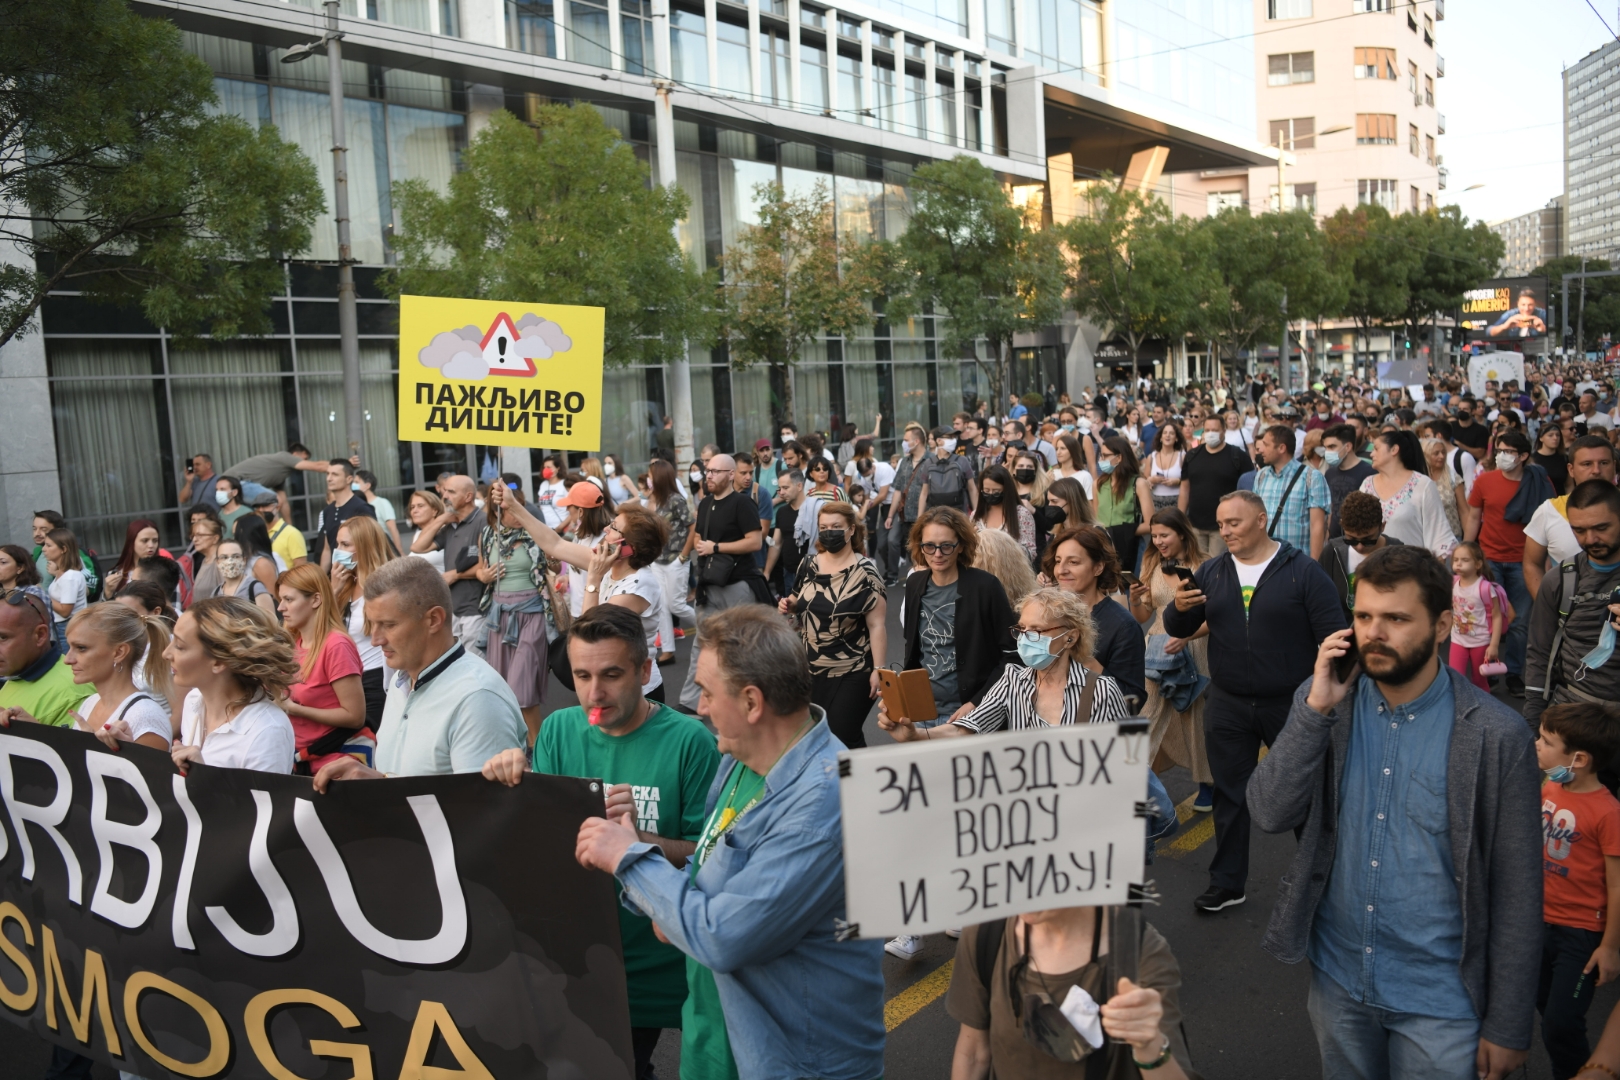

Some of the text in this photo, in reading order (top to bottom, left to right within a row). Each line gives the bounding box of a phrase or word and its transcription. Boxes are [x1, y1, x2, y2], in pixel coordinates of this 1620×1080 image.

[415, 382, 585, 413] ПАЖЉИВО
[425, 406, 573, 436] ДИШИТЕ!
[875, 737, 1116, 814] ЗА ВАЗДУХ
[0, 734, 468, 965] RBIJU
[954, 794, 1060, 858] ВОДУ
[900, 842, 1114, 925] И ЗЕМЉУ!
[0, 901, 497, 1080] SMOGA
